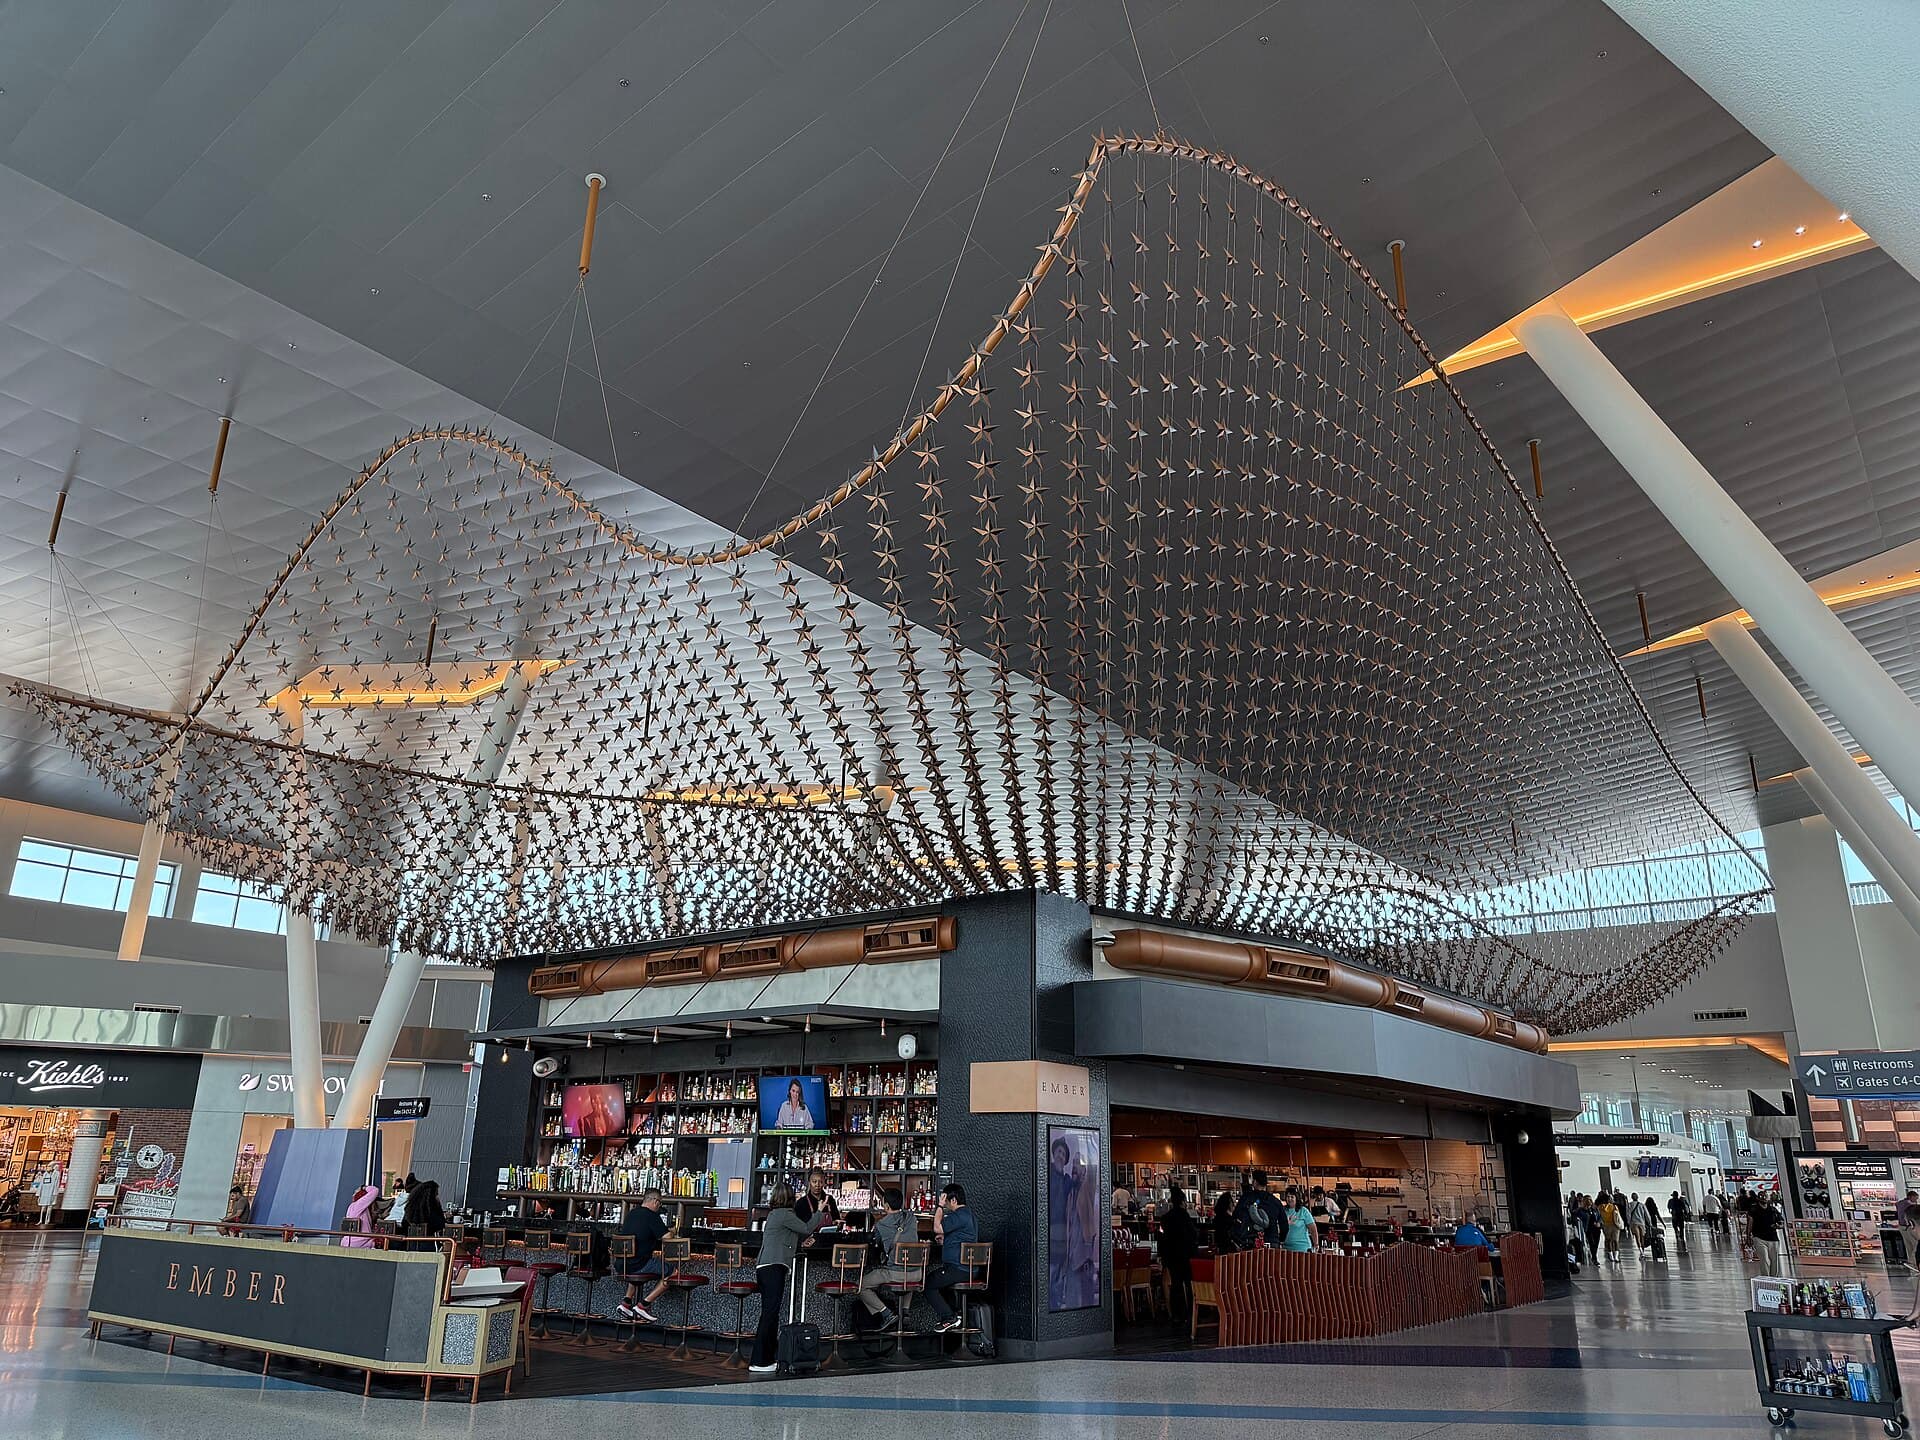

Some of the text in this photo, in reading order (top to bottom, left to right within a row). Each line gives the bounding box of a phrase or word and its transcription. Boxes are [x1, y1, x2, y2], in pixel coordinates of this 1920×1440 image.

[1853, 1060, 1914, 1070] Restrooms
[17, 1060, 104, 1085] Kiehl's
[1042, 1081, 1086, 1096] EMBER
[1856, 1077, 1889, 1087] Gates
[167, 1262, 287, 1305] EMBER
[1762, 1293, 1780, 1304] AVISS
